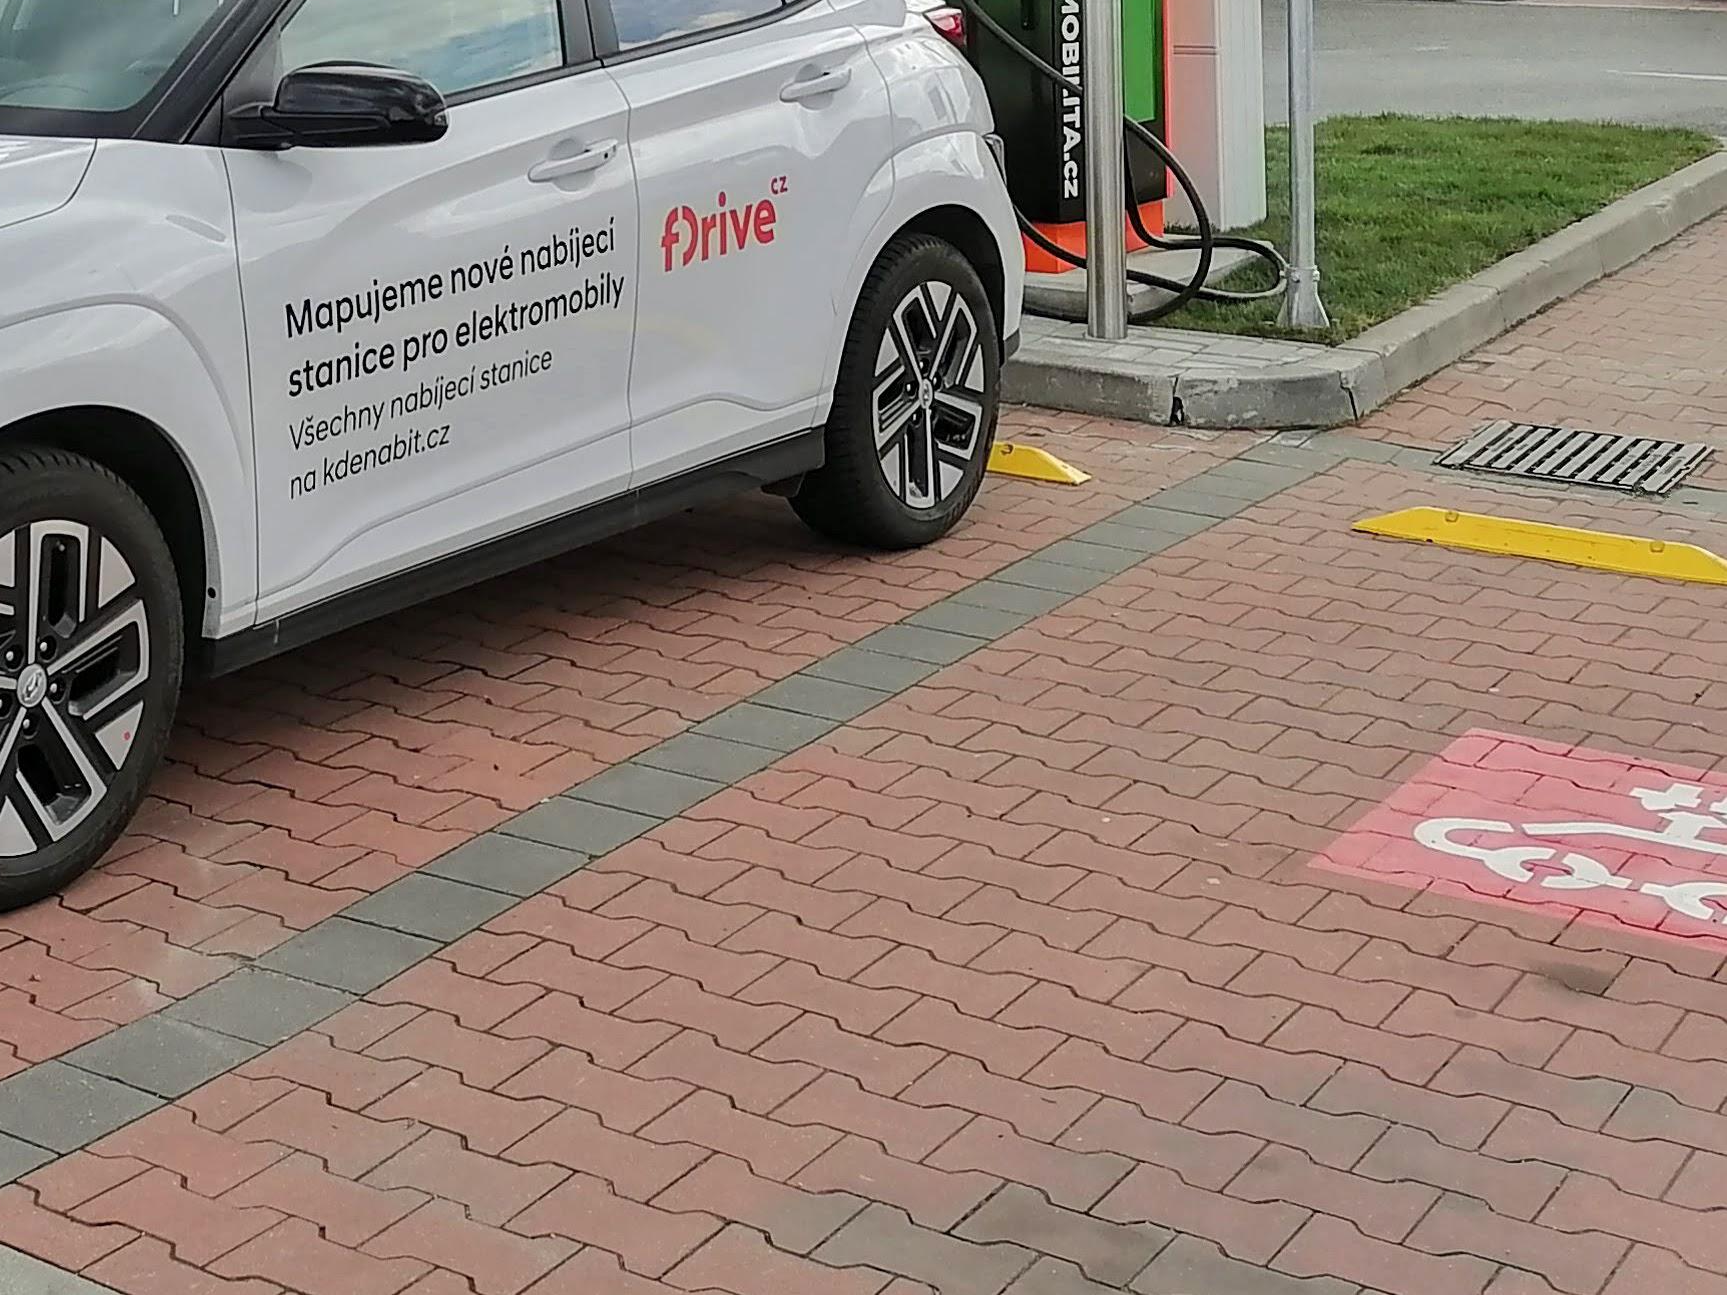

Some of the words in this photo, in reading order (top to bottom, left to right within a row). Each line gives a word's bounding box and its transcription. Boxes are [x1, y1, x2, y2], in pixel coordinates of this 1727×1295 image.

[285, 274, 443, 338] Mapujeme
[450, 245, 514, 294] nové
[520, 217, 616, 275] nabíjecí
[288, 340, 395, 397] stanice
[403, 326, 448, 372] pro
[455, 274, 625, 348] elektromobily
[289, 398, 385, 451] Všechny
[390, 365, 477, 419] nabíjecí
[480, 349, 553, 391] stanice
[290, 470, 316, 500] na
[323, 423, 451, 487] kdenabit.cz
